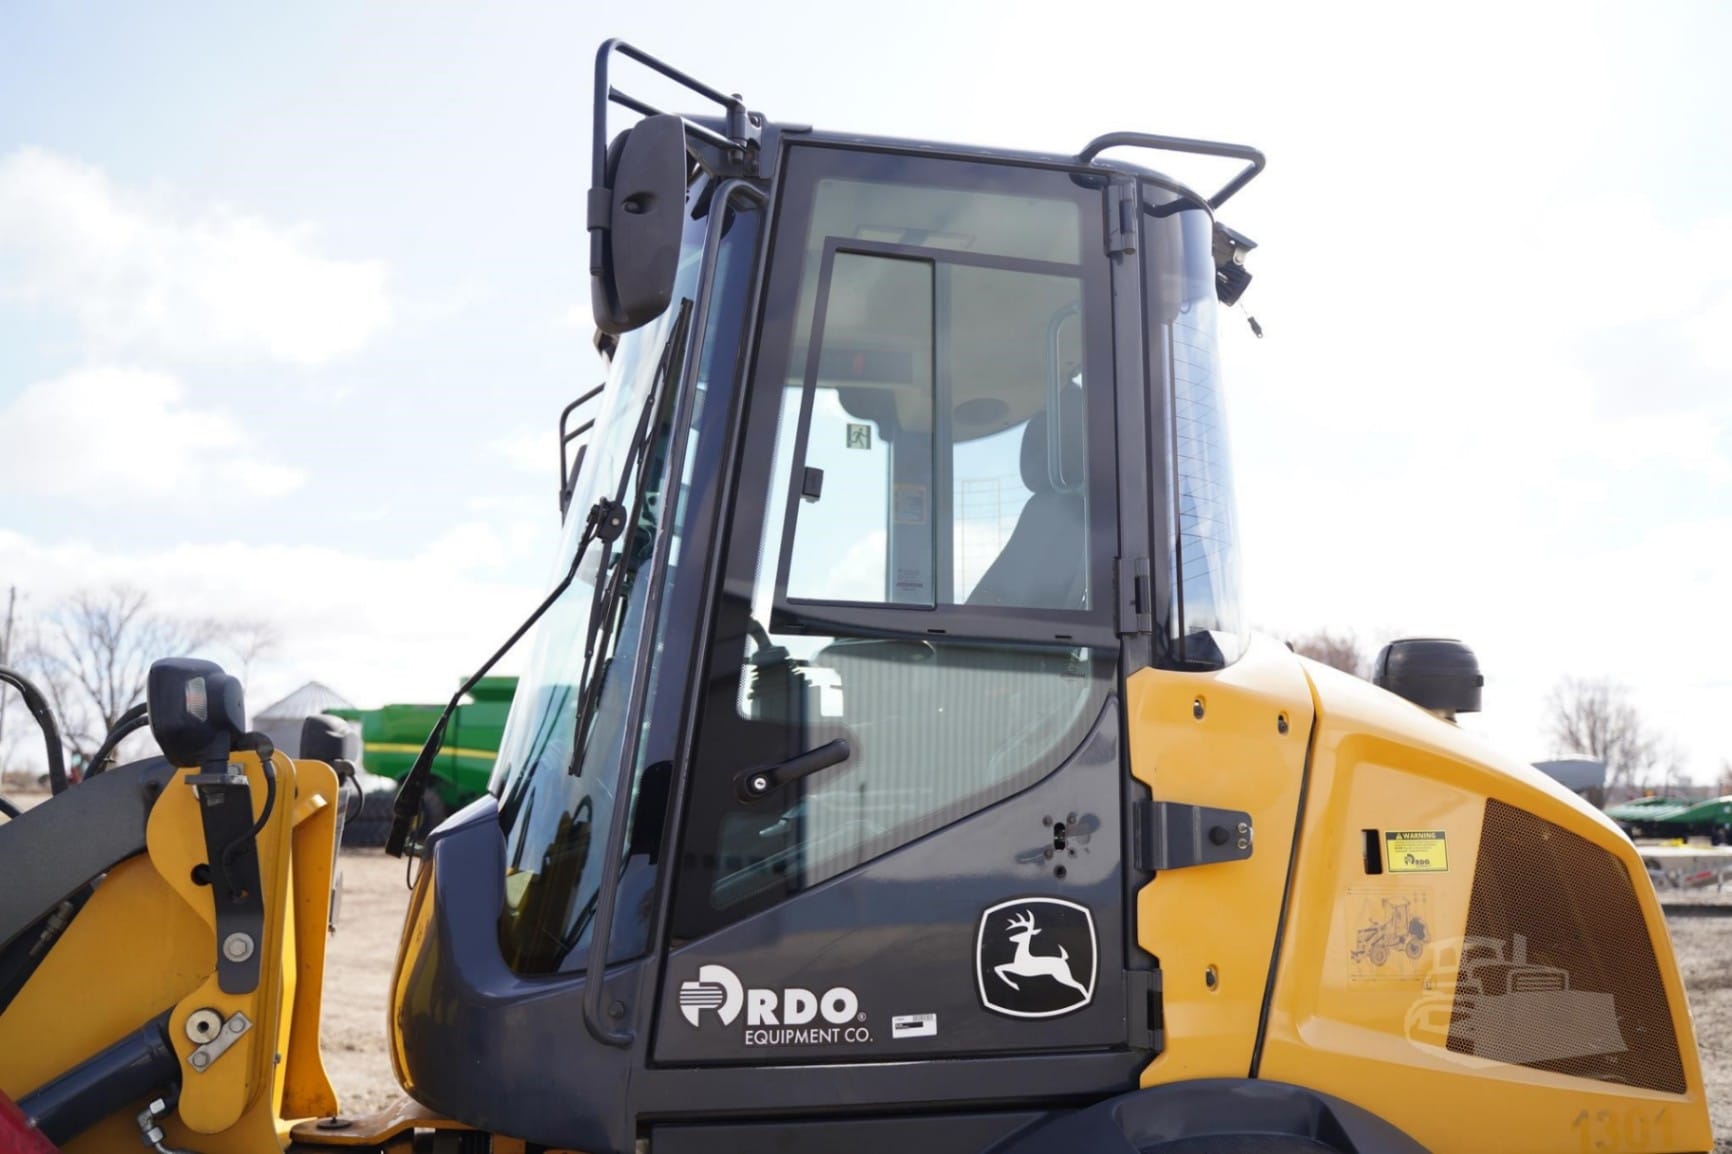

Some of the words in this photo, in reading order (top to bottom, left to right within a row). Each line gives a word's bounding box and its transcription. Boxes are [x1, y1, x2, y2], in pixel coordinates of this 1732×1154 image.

[1402, 832, 1436, 840] WARNING
[745, 1029, 840, 1046] EQUIPMENT
[844, 1027, 874, 1043] CO.
